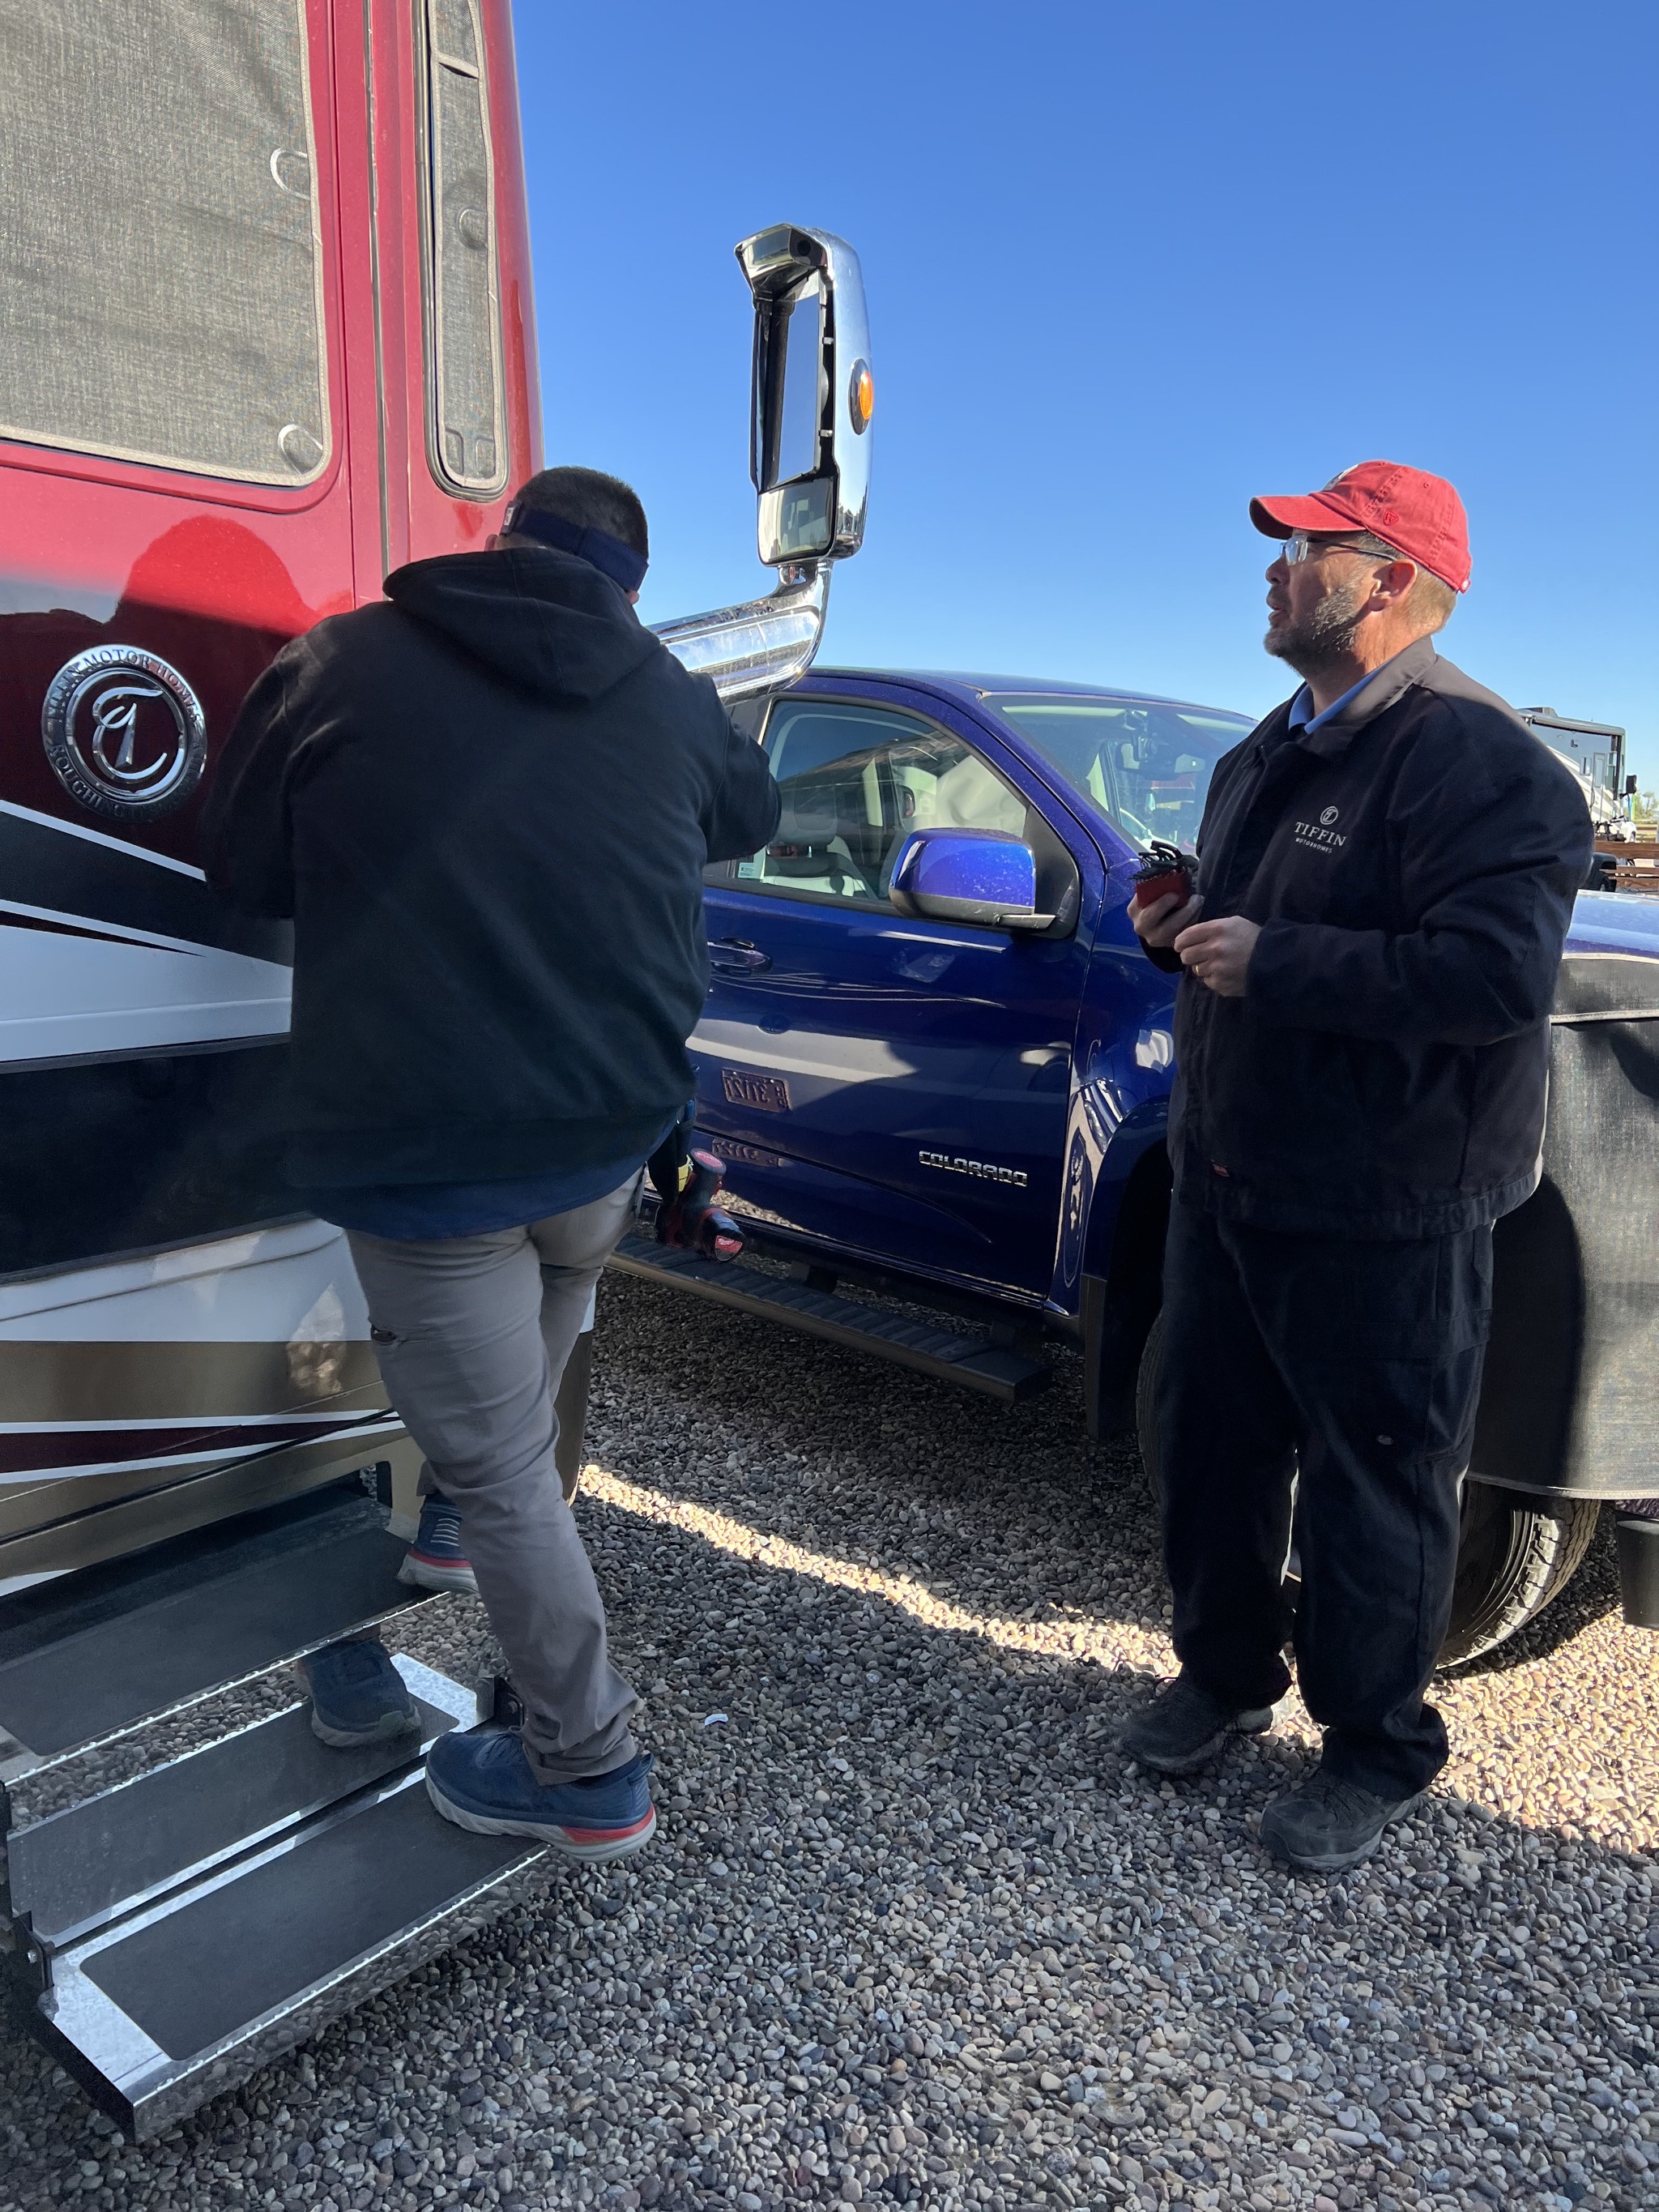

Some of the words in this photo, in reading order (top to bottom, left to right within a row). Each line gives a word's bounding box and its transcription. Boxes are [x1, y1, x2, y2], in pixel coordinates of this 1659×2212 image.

[83, 648, 151, 669] MOTOR
[156, 663, 203, 724] HOMES
[1294, 822, 1347, 846] TIFFIN
[919, 1151, 1027, 1186] COLORADO
